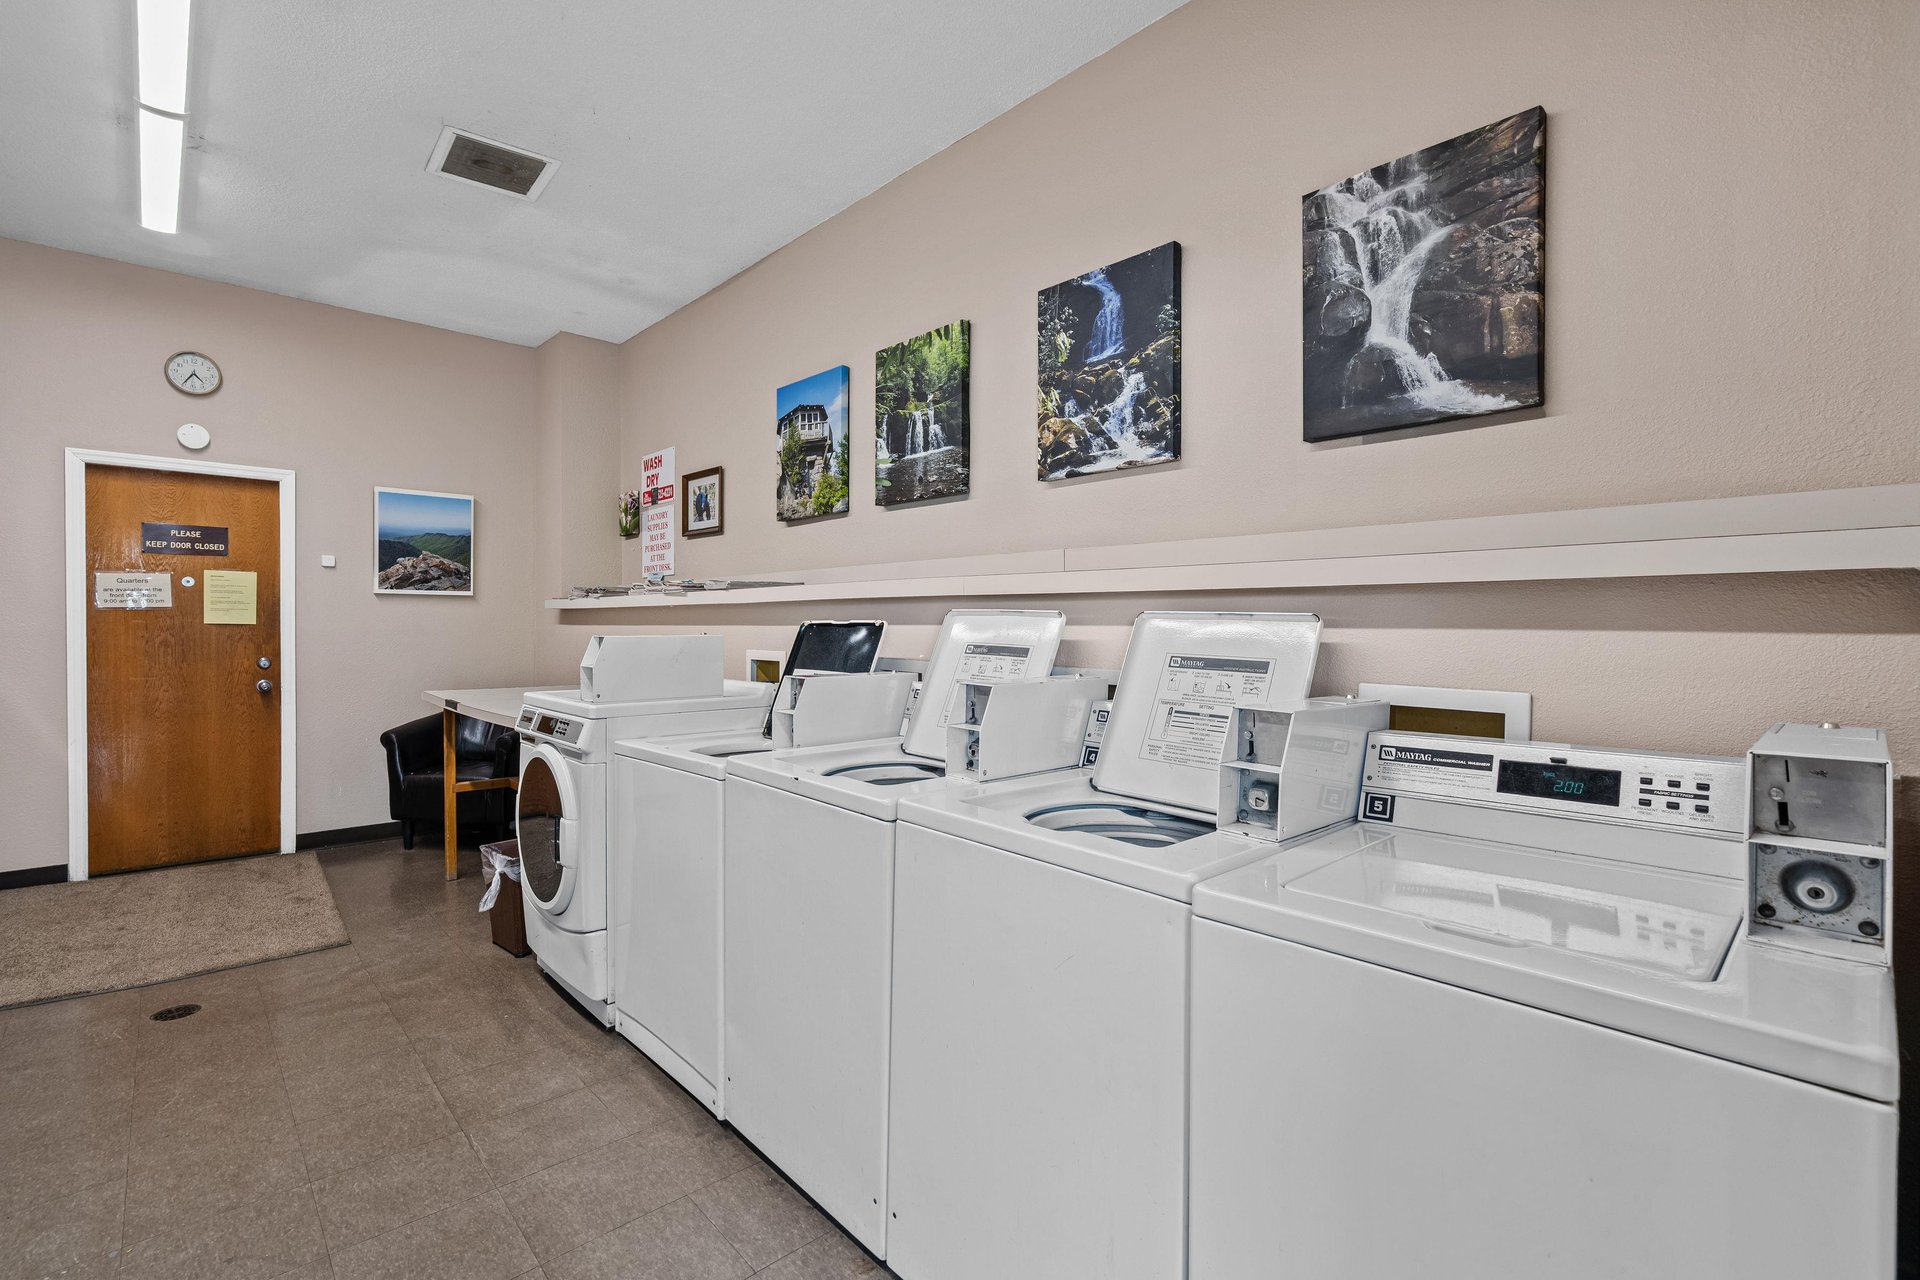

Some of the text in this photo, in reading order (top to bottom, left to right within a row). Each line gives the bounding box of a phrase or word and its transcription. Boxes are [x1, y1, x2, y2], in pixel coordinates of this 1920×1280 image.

[644, 455, 662, 472] WASH
[647, 472, 659, 488] DRY
[648, 511, 668, 522] LAUNDRY
[648, 522, 668, 532] SUPPLIES
[170, 530, 202, 538] PLEASE
[650, 532, 666, 542] MAY BE
[645, 542, 671, 552] PURCHASED
[656, 553, 665, 561] THE
[644, 565, 658, 573] FRONT
[1089, 753, 1095, 761] 4
[1396, 751, 1432, 761] MAYTAG
[1554, 780, 1584, 794] 2.00
[1374, 801, 1383, 812] 5
